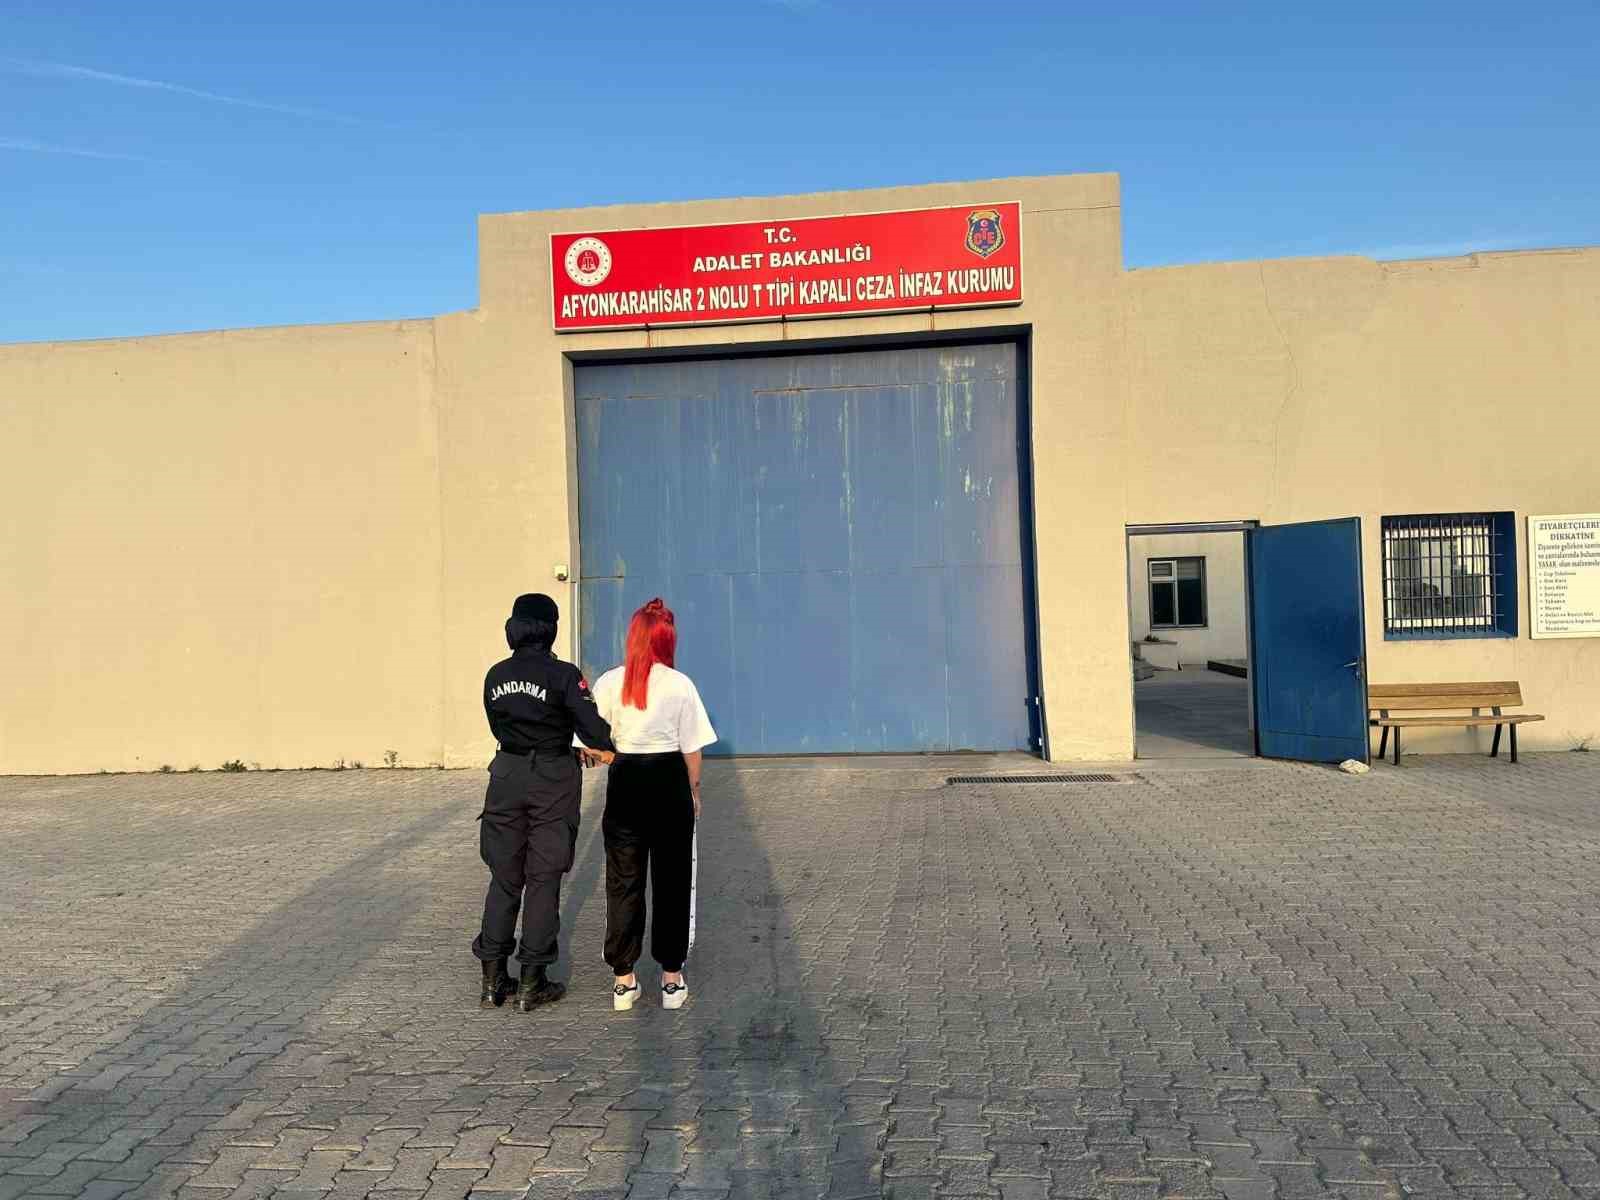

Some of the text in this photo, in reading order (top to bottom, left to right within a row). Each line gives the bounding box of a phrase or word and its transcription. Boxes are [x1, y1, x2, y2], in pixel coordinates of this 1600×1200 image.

[764, 227, 796, 244] T.C.
[693, 243, 871, 272] ADALET BAKANLIĞI
[561, 266, 1014, 318] AFYONKARAHİSAR 2 NOLU T TİPİ KAPALI CEZA İNFAZ KURUMU
[491, 681, 547, 702] JANDARMA
